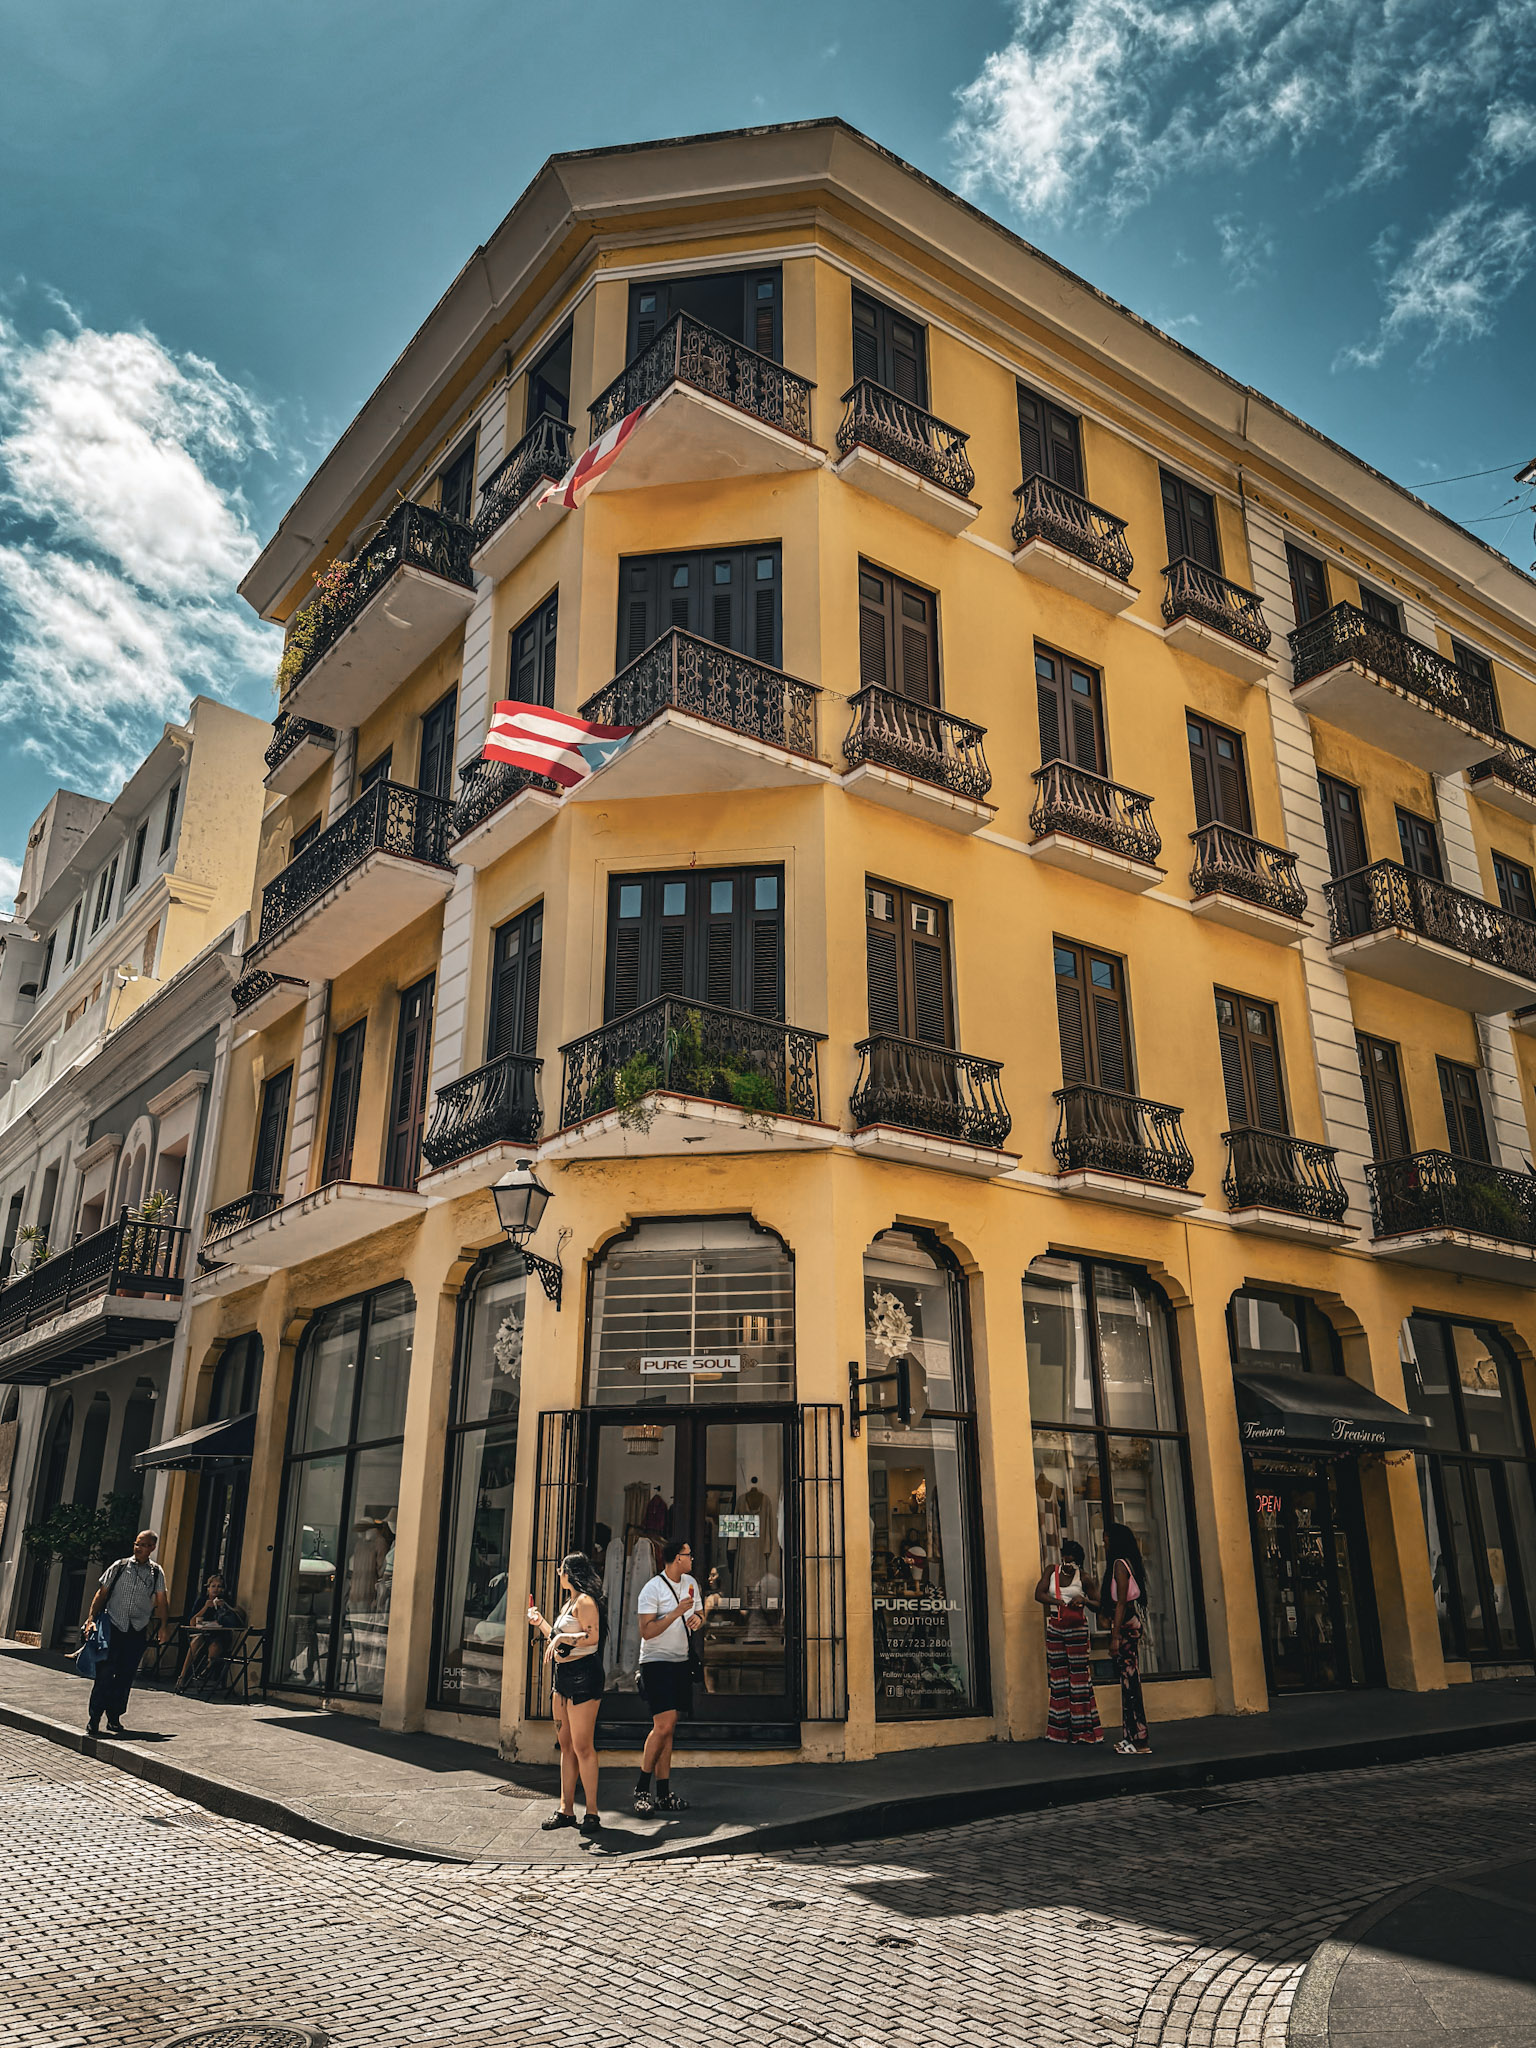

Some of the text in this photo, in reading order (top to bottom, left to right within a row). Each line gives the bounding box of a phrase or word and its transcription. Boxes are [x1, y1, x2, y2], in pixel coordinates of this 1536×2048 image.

[644, 1359, 736, 1370] PURE SOUL
[1243, 1421, 1286, 1438] Treasures
[1331, 1418, 1386, 1443] Treasures
[874, 1598, 962, 1611] PURE SOUL
[893, 1616, 945, 1626] BOUTIQUE
[887, 1639, 953, 1648] 787.723.2800
[443, 1667, 467, 1676] PURE
[442, 1680, 467, 1689] SOUL
